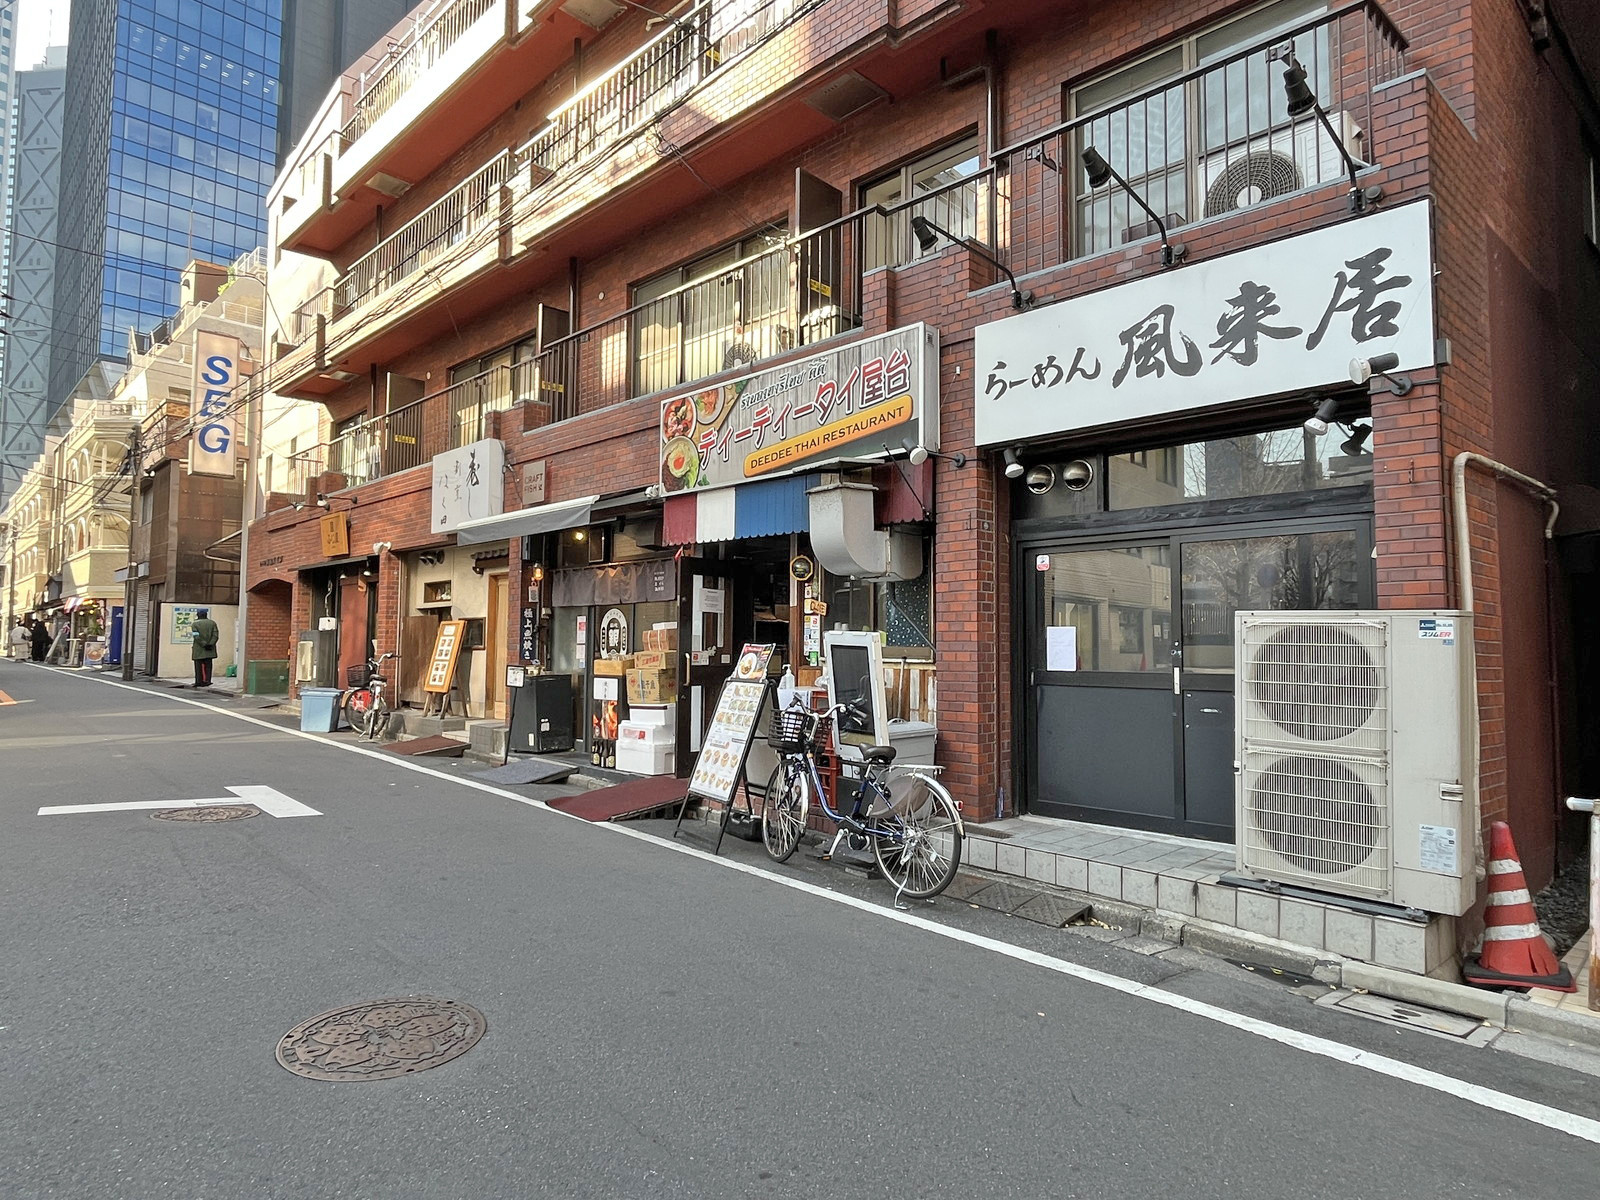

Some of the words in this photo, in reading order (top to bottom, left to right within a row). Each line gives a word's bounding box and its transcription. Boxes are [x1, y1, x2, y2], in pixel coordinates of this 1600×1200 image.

[984, 346, 1101, 402] らーめん
[1111, 246, 1413, 390] 風来居
[198, 355, 232, 454] SEG
[698, 348, 912, 469] ディーディータイ屋台
[750, 447, 793, 470] DEEDEE
[794, 436, 821, 454] THAI
[823, 406, 905, 444] RESTAURANT
[524, 473, 543, 485] CRAFT
